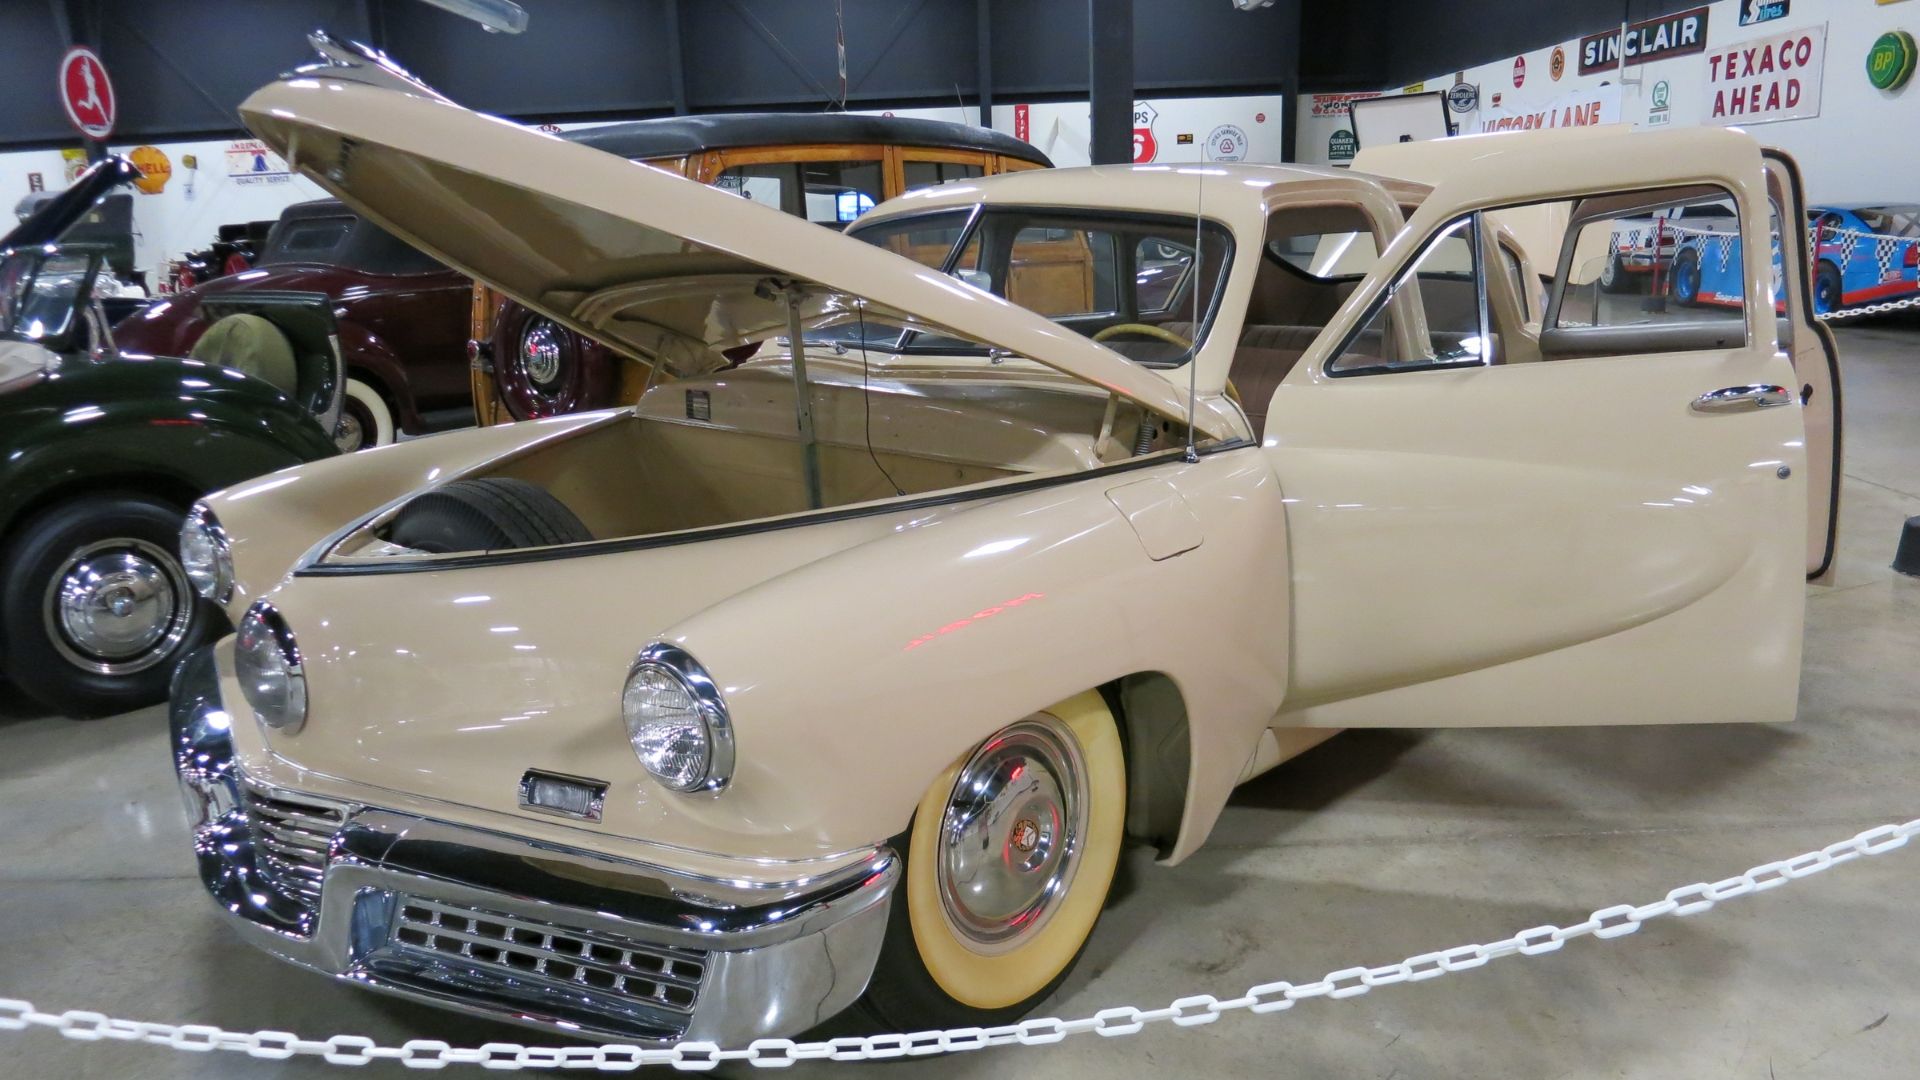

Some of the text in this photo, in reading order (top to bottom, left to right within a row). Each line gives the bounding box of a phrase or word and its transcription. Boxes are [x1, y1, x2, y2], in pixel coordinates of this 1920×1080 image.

[1584, 16, 1698, 66] SINCLAIR
[1709, 36, 1812, 82] TEXACO
[1873, 51, 1894, 71] BP
[1712, 79, 1801, 118] AHEAD
[1134, 112, 1148, 124] PS
[1482, 112, 1546, 133] VICTORY
[1550, 101, 1601, 129] LANE
[1134, 134, 1145, 160] 6
